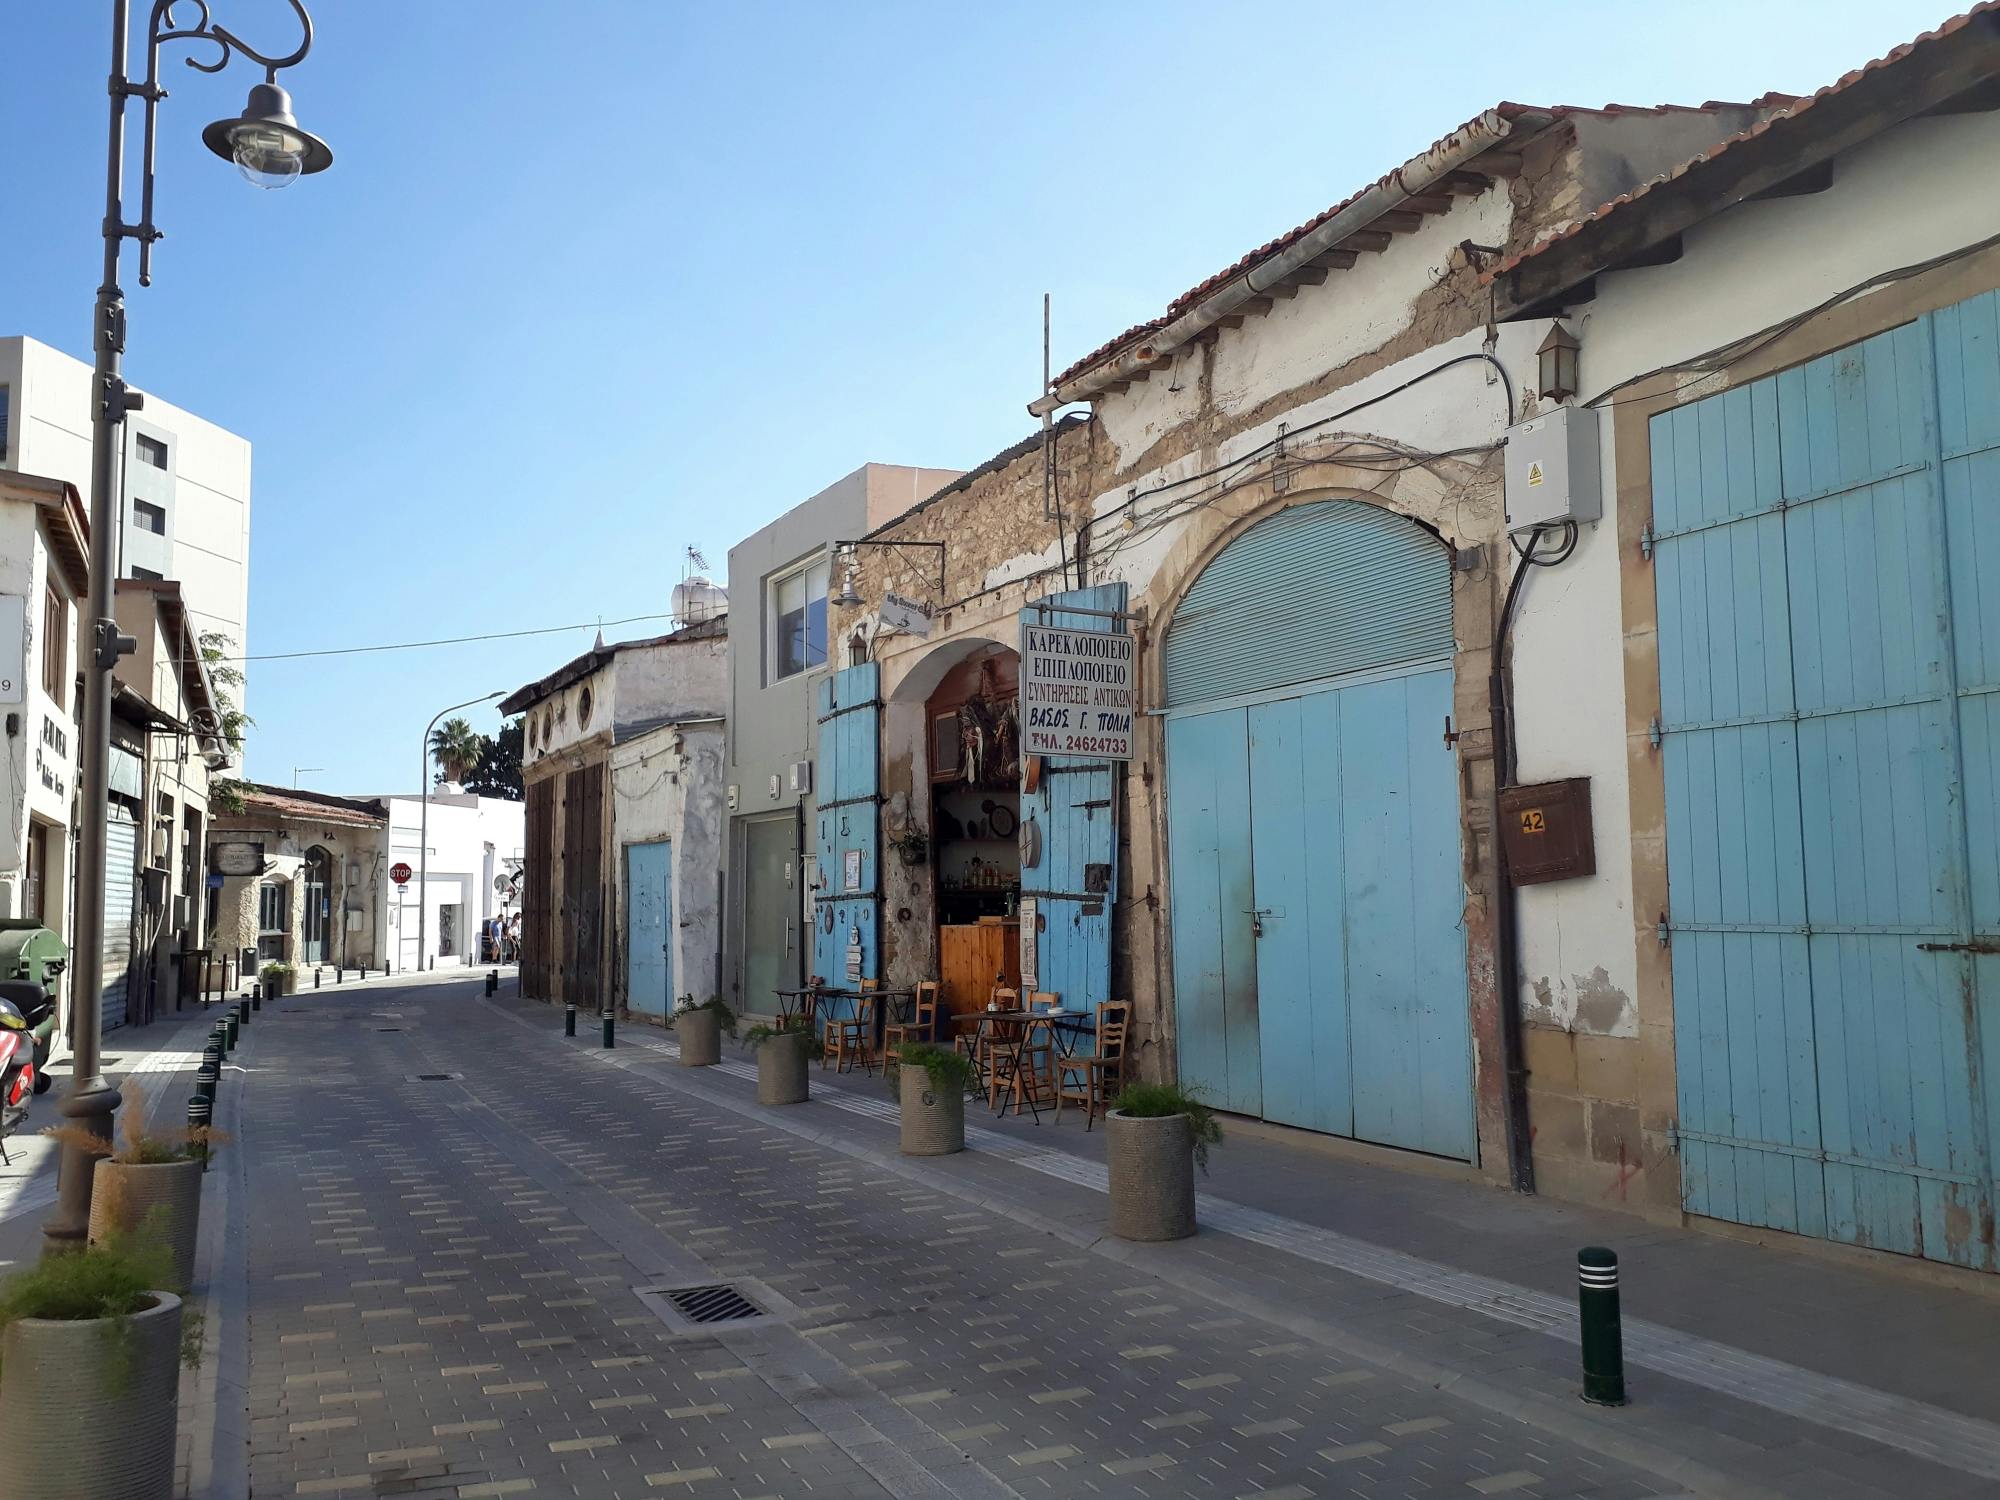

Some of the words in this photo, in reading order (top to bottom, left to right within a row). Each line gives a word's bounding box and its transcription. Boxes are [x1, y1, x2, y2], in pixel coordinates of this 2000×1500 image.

[1029, 631, 1130, 660] ΚΑΡΕΚΛΟΠΟΙΕΙΟ
[1034, 657, 1126, 684] ΕΠΙΠΛΟΠΟΙΕΙΟ
[1028, 682, 1089, 705] ΣΥΝΤΗΡΗΣΕΙΣ
[1093, 687, 1131, 708] ΑΝΤΙΚΩΝ
[1029, 707, 1070, 728] ΒΑΣΟΣ
[1079, 712, 1087, 730] Γ.
[1031, 732, 1062, 749] ΤΗΛ.
[1066, 735, 1127, 753] 24624733
[1522, 812, 1543, 830] 42
[390, 869, 411, 877] STOP
